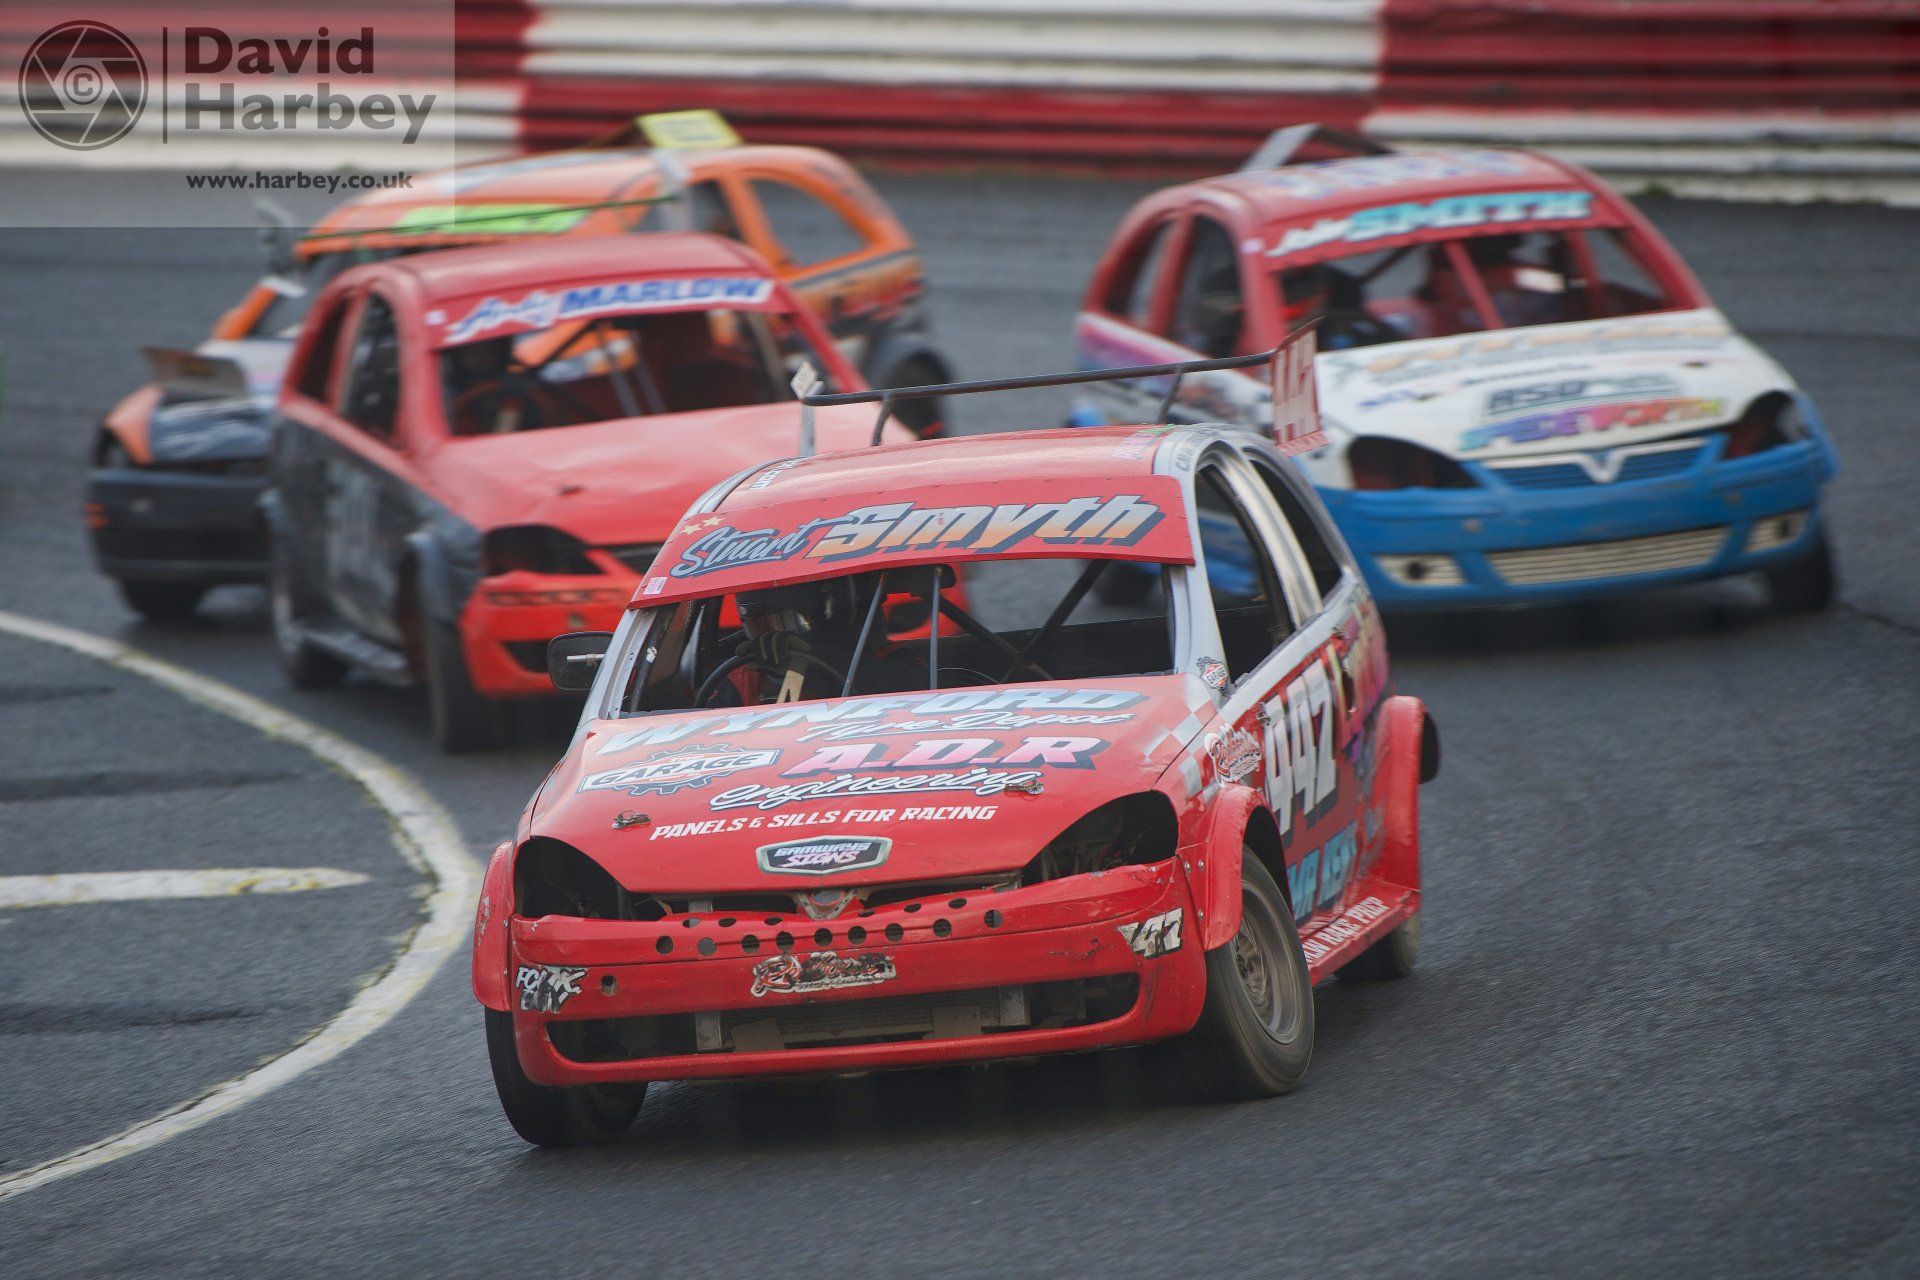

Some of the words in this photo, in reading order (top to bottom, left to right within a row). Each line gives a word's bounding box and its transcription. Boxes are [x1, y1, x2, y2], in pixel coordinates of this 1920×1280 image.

[669, 517, 860, 577] Stuart
[805, 494, 1166, 561] Smyth
[596, 688, 1152, 756] WYNFORD
[590, 752, 766, 788] GARAGE
[1264, 658, 1338, 836] 447
[710, 767, 1044, 813] engineering
[649, 816, 744, 841] PANELS
[749, 816, 763, 829] &
[767, 809, 845, 829] SILLS
[841, 806, 893, 824] FOR
[898, 804, 999, 822] RACING
[1345, 896, 1390, 924] PREP
